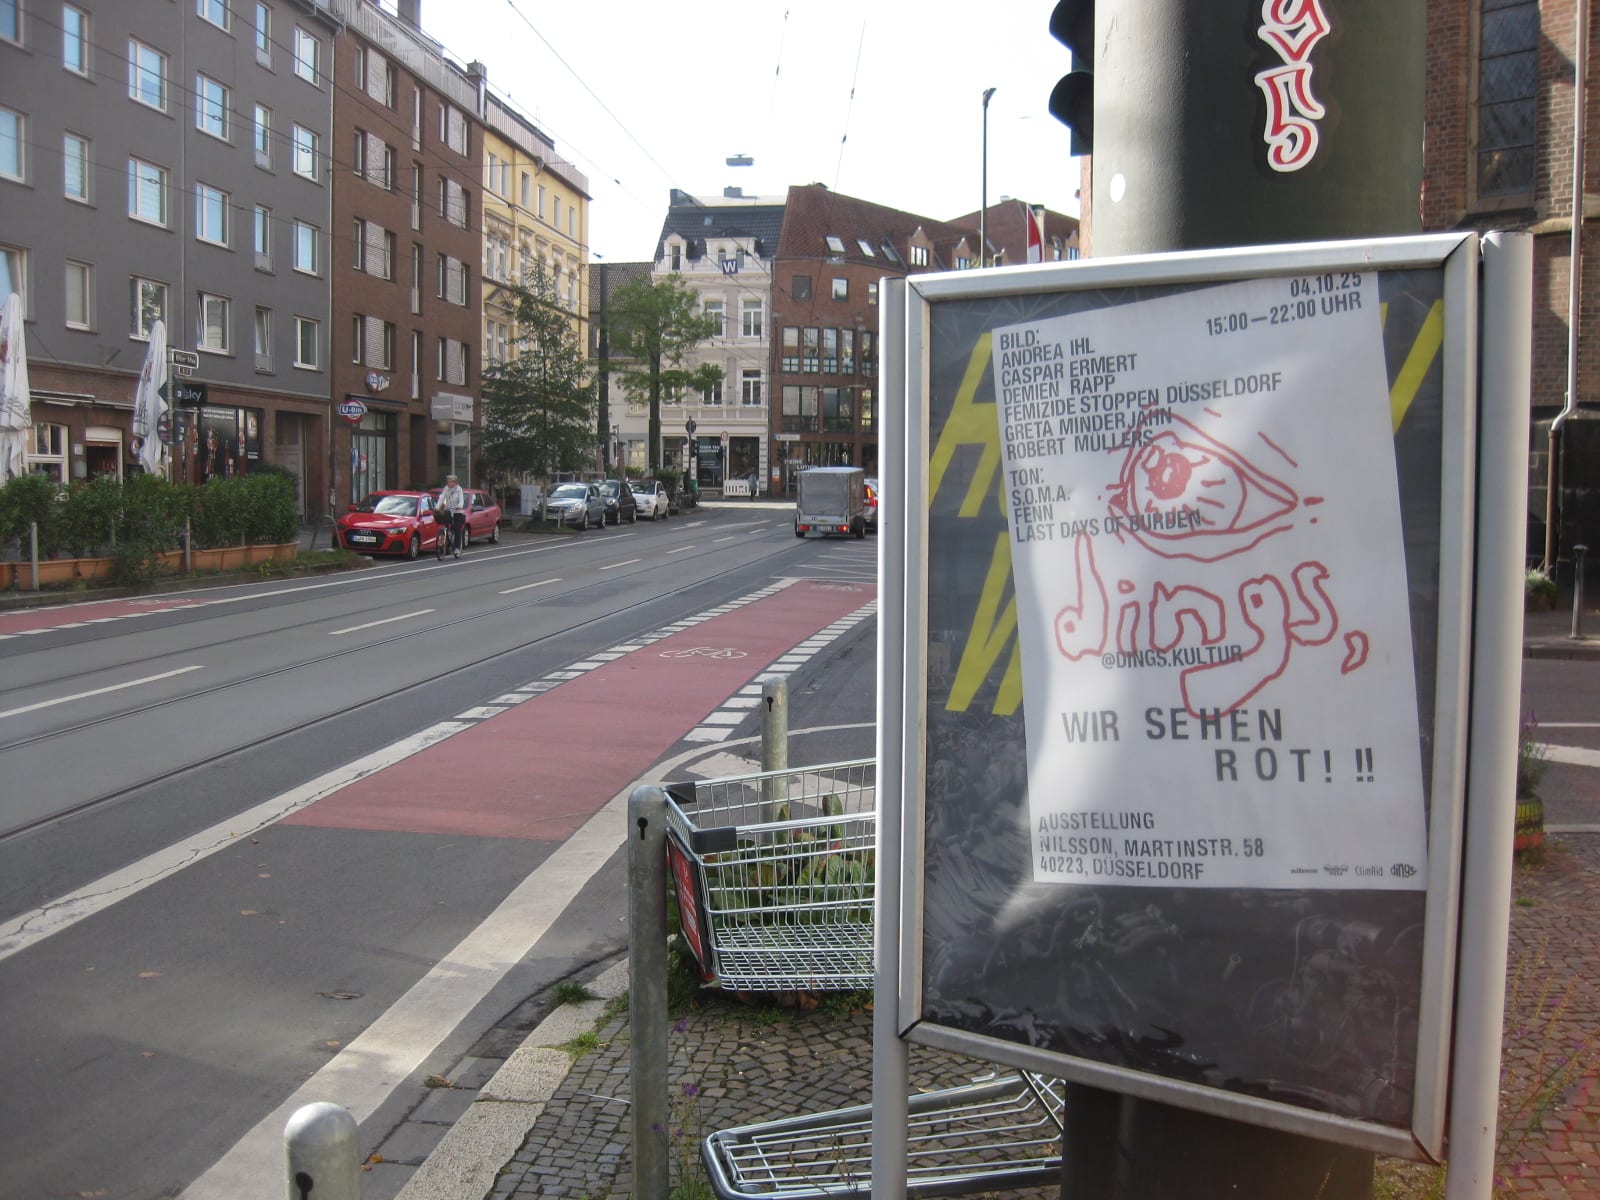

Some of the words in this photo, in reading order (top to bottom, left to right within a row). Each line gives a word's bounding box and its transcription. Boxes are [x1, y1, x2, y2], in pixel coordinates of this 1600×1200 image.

[1290, 272, 1362, 298] 04.10.25
[1321, 291, 1362, 316] UHR
[1000, 328, 1040, 351] BILD:
[1001, 343, 1064, 370] ANDREA
[1069, 337, 1096, 356] IHL
[1001, 362, 1064, 388] CASPAR
[1069, 353, 1138, 378] ERMERT
[1003, 380, 1060, 406] DEMIEN
[1069, 374, 1116, 396] RAPP
[1004, 397, 1077, 423] FEMIZIDE
[1080, 389, 1160, 414] STOPPEN
[1166, 371, 1283, 405] DÜSSELDORF
[1005, 421, 1052, 443] GRETA
[1007, 437, 1066, 461] ROBERT
[1074, 429, 1154, 453] MÜLLERS
[1010, 467, 1045, 488] TON:
[1012, 485, 1072, 507] S.O.M.A.
[1014, 504, 1054, 525] FENN
[1016, 523, 1055, 543] LAST
[1060, 518, 1100, 540] DAYS
[1104, 515, 1125, 535] OF
[1129, 508, 1202, 532] BURDEN
[1101, 644, 1244, 670] @DINGS.KULTUR
[1061, 709, 1120, 743] WIR
[1144, 706, 1283, 743] SEHEN
[1038, 812, 1155, 833] AUSSTELLUNG
[1040, 836, 1119, 858] NILSSON,
[1124, 838, 1239, 858] MARTINSTR.
[1243, 838, 1265, 858] 58
[1040, 855, 1089, 877] 40223,
[1093, 855, 1205, 881] DÜSSELDORF
